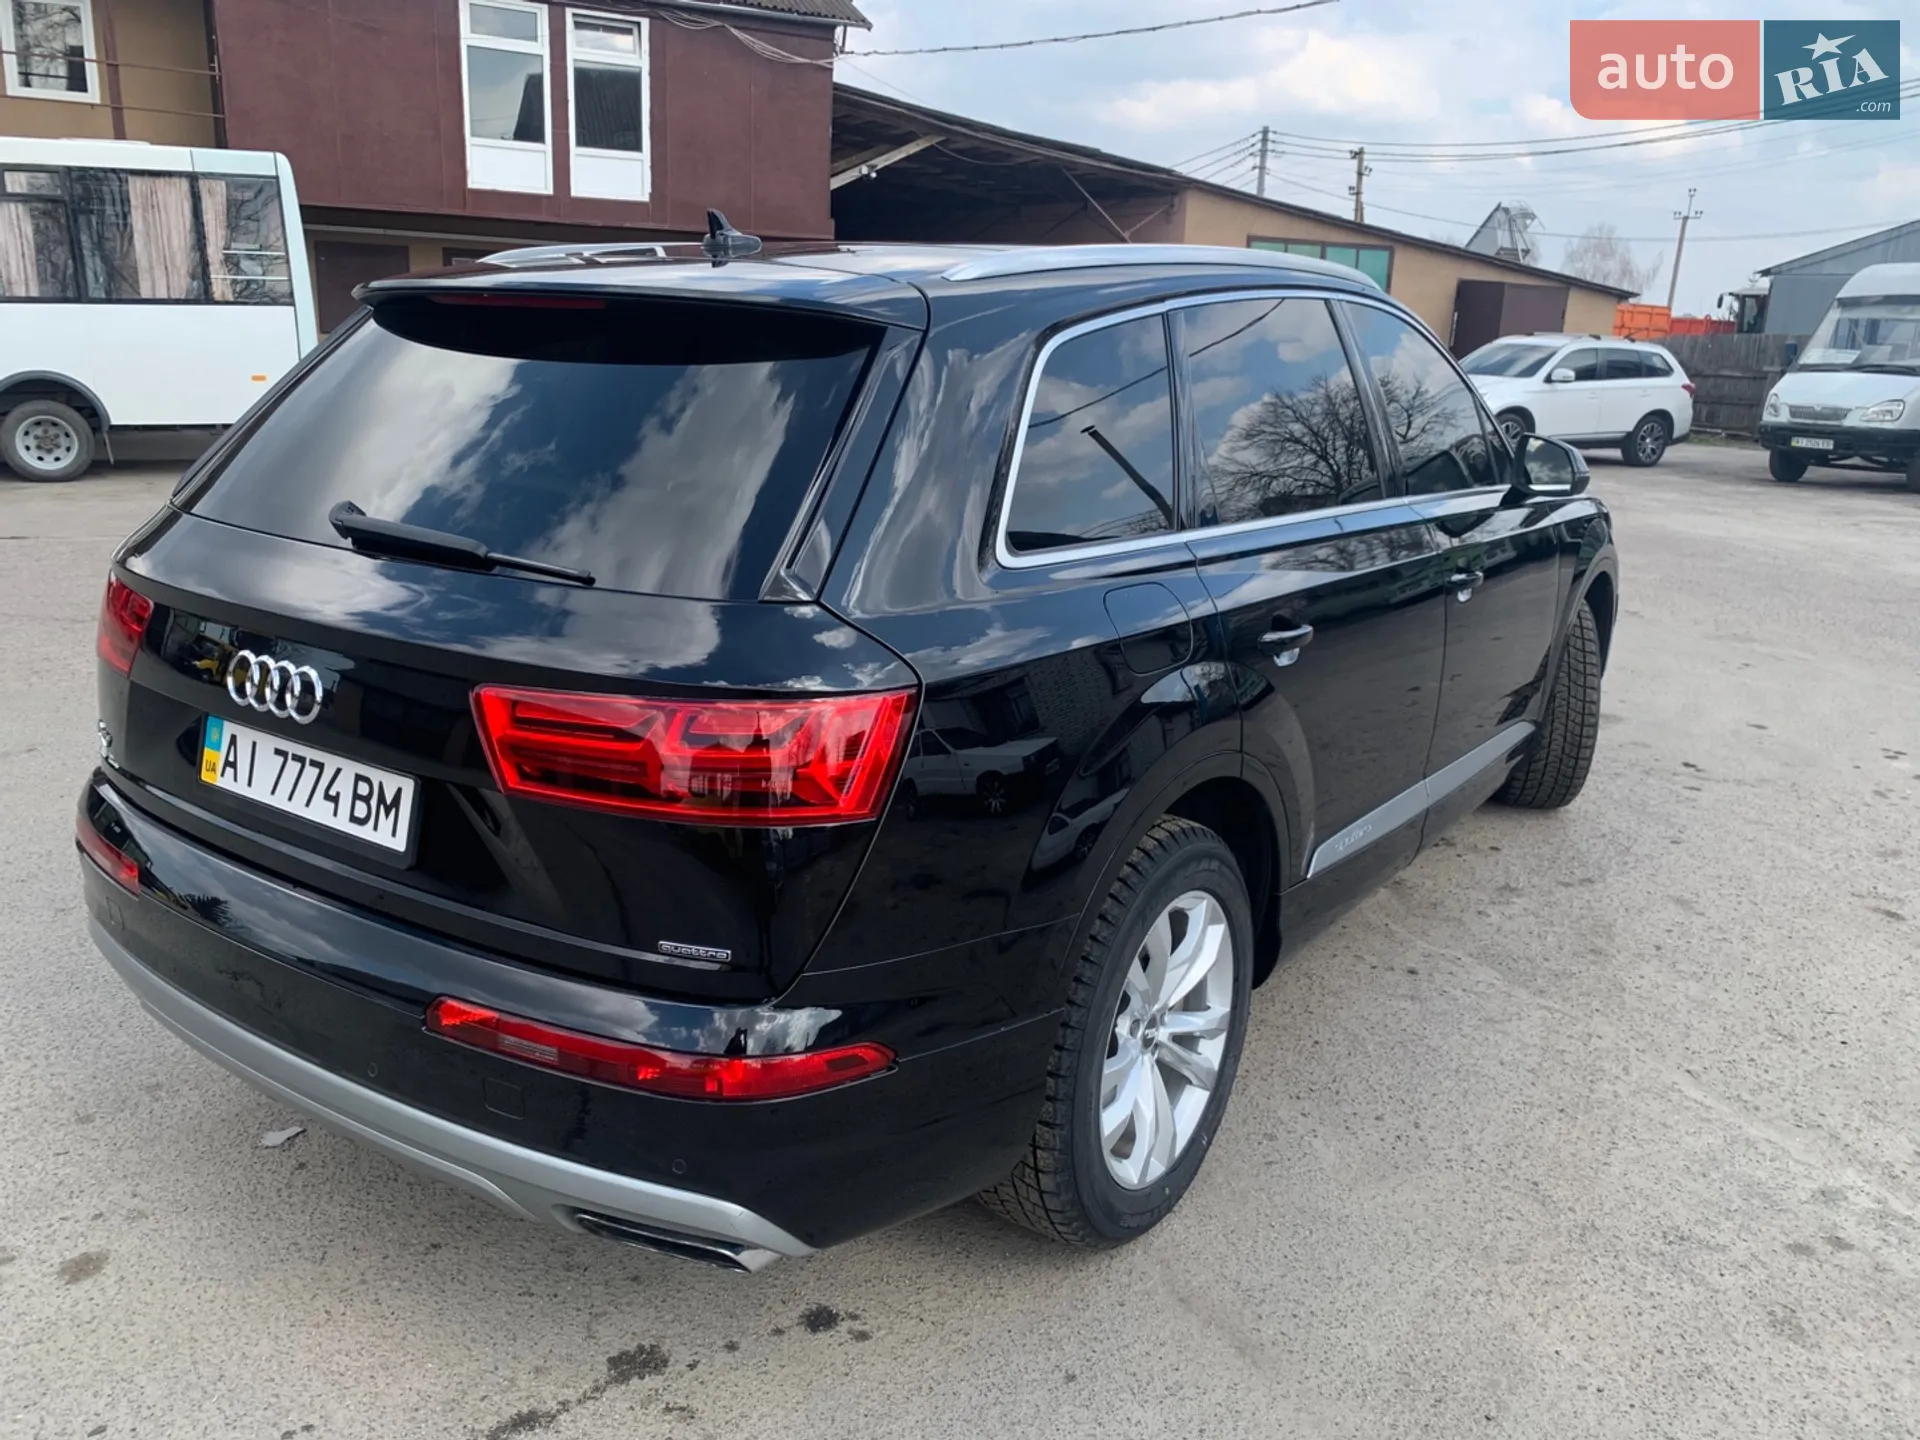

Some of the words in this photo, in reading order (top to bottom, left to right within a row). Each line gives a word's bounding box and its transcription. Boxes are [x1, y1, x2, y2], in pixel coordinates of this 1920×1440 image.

[205, 759, 217, 775] UA
[221, 733, 257, 788] AI
[270, 747, 343, 818] 7774
[348, 772, 403, 838] BM
[661, 944, 728, 959] quattro
